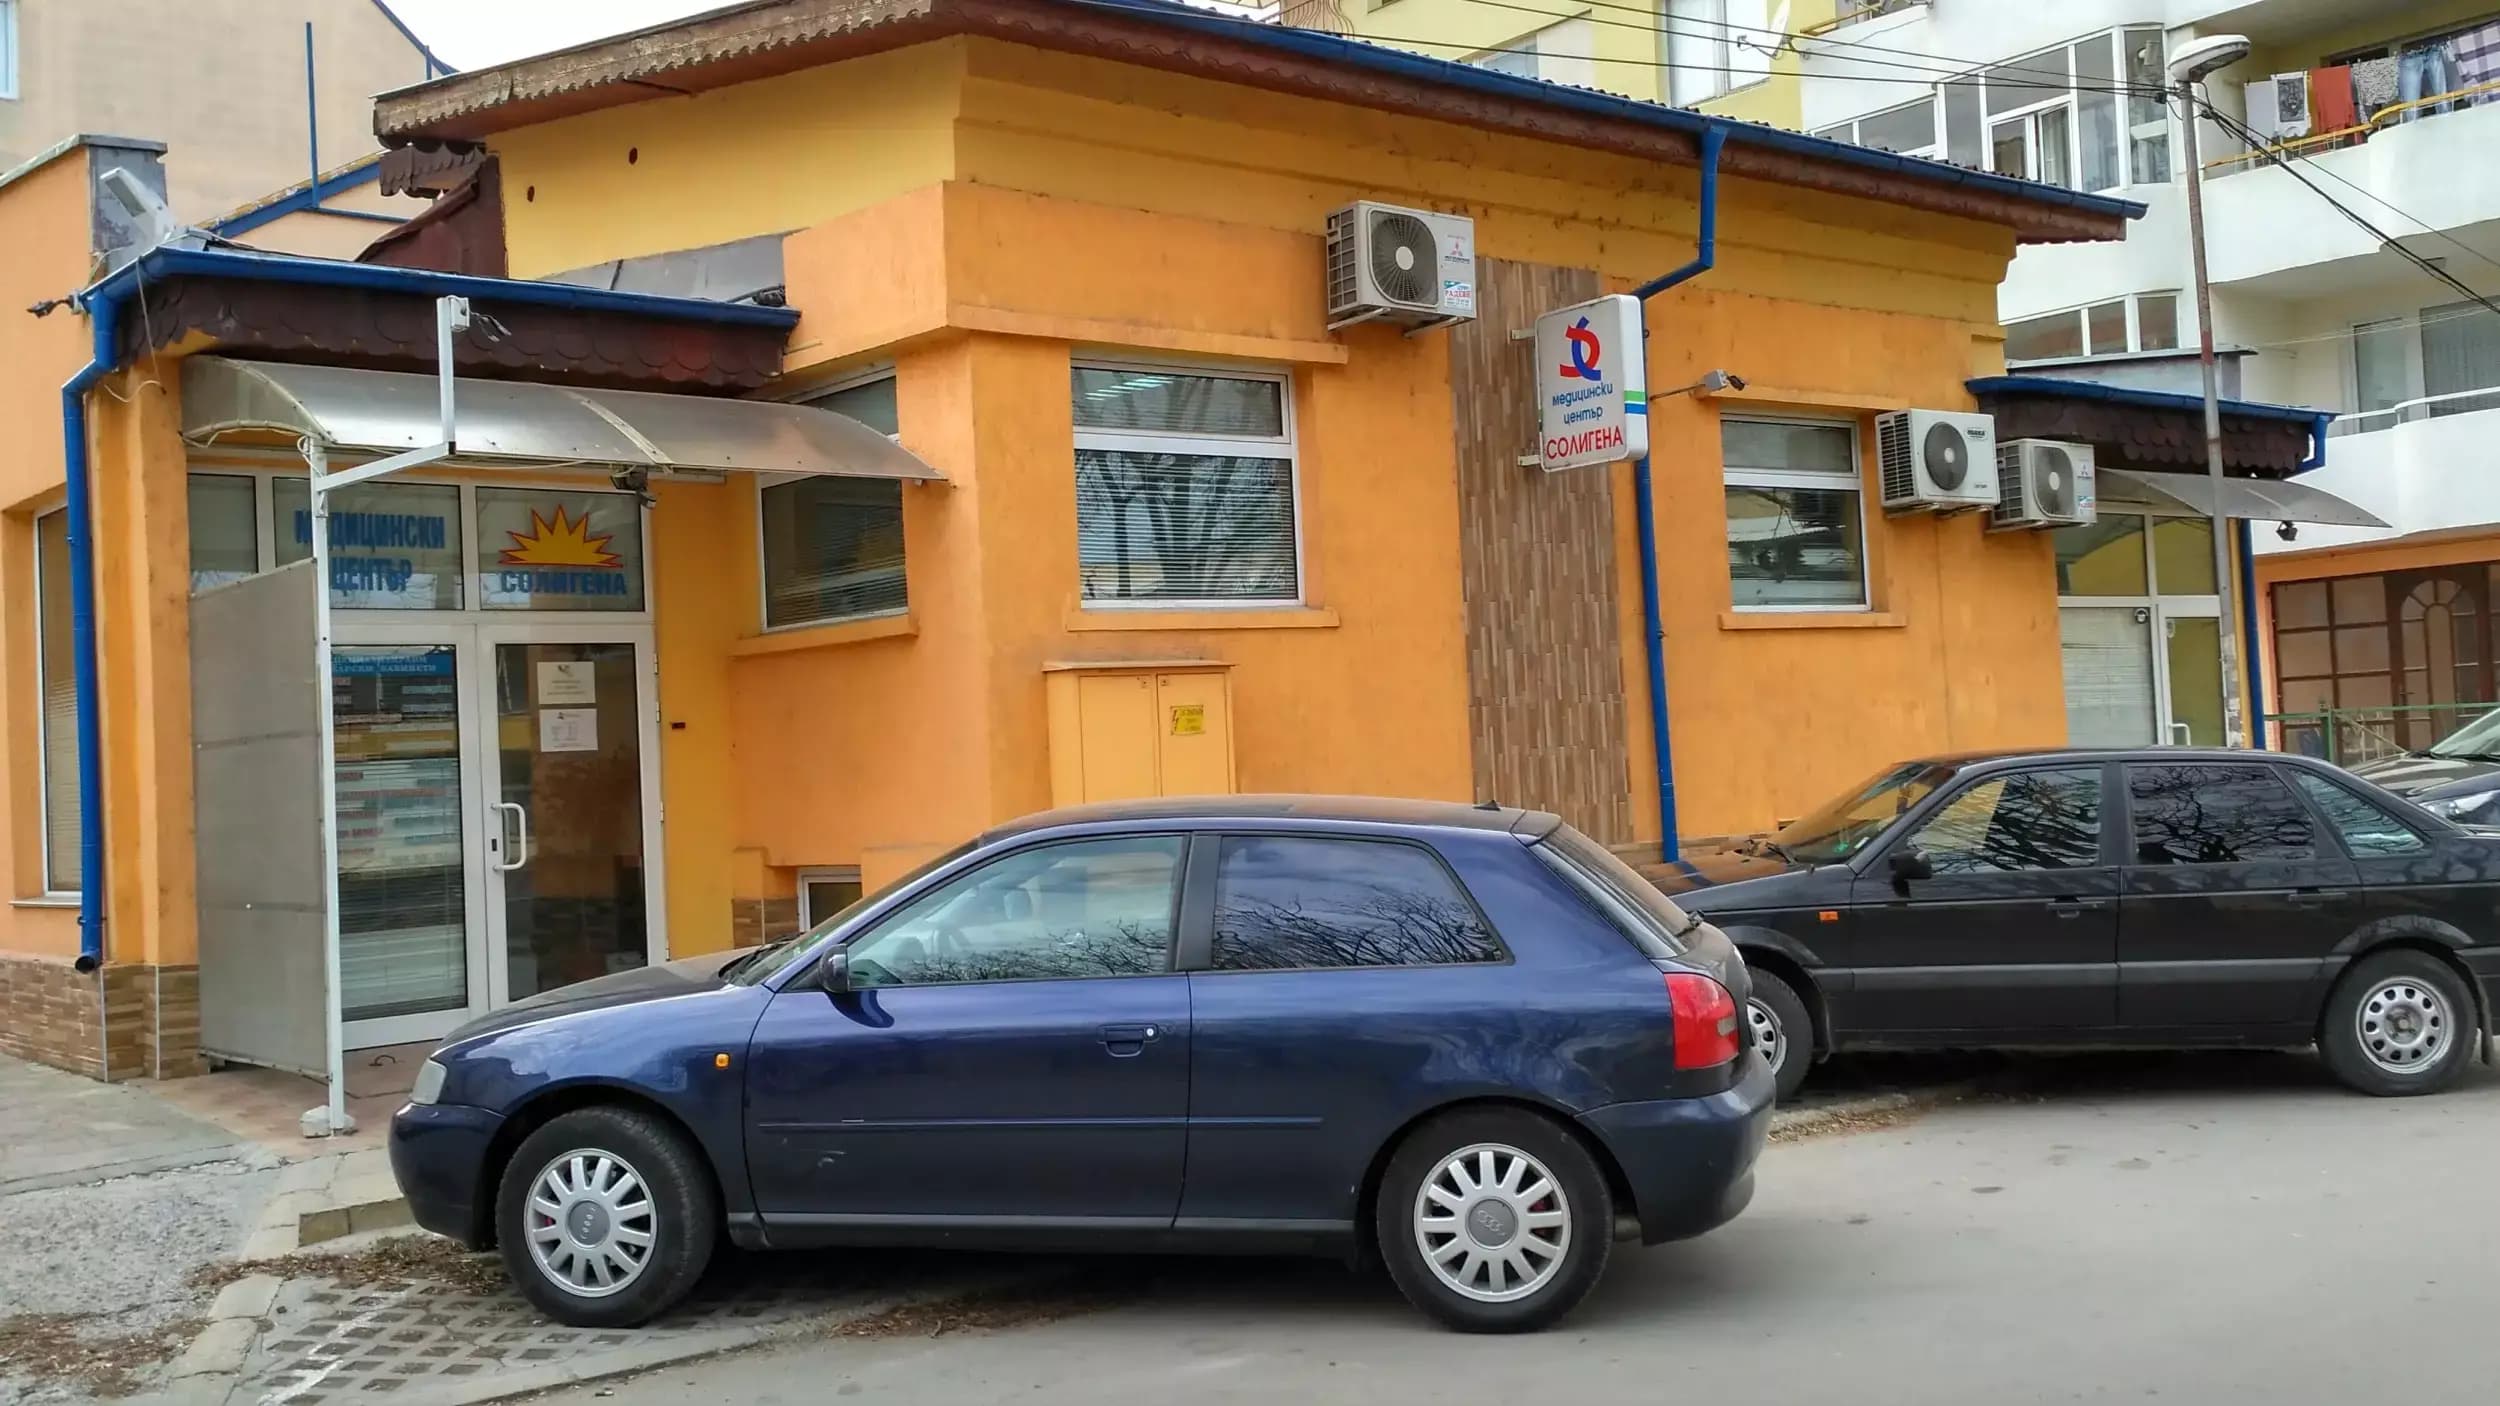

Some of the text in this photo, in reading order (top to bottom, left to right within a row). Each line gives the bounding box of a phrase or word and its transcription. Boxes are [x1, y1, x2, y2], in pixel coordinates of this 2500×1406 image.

[1552, 382, 1613, 407] медицински
[1563, 406, 1603, 426] център
[1546, 425, 1624, 459] СОЛИГЕНА
[294, 510, 445, 552] МДИЦИНСКИ
[331, 556, 413, 597] ЦЕНТЪР
[500, 570, 627, 595] СОЛИГЕНА
